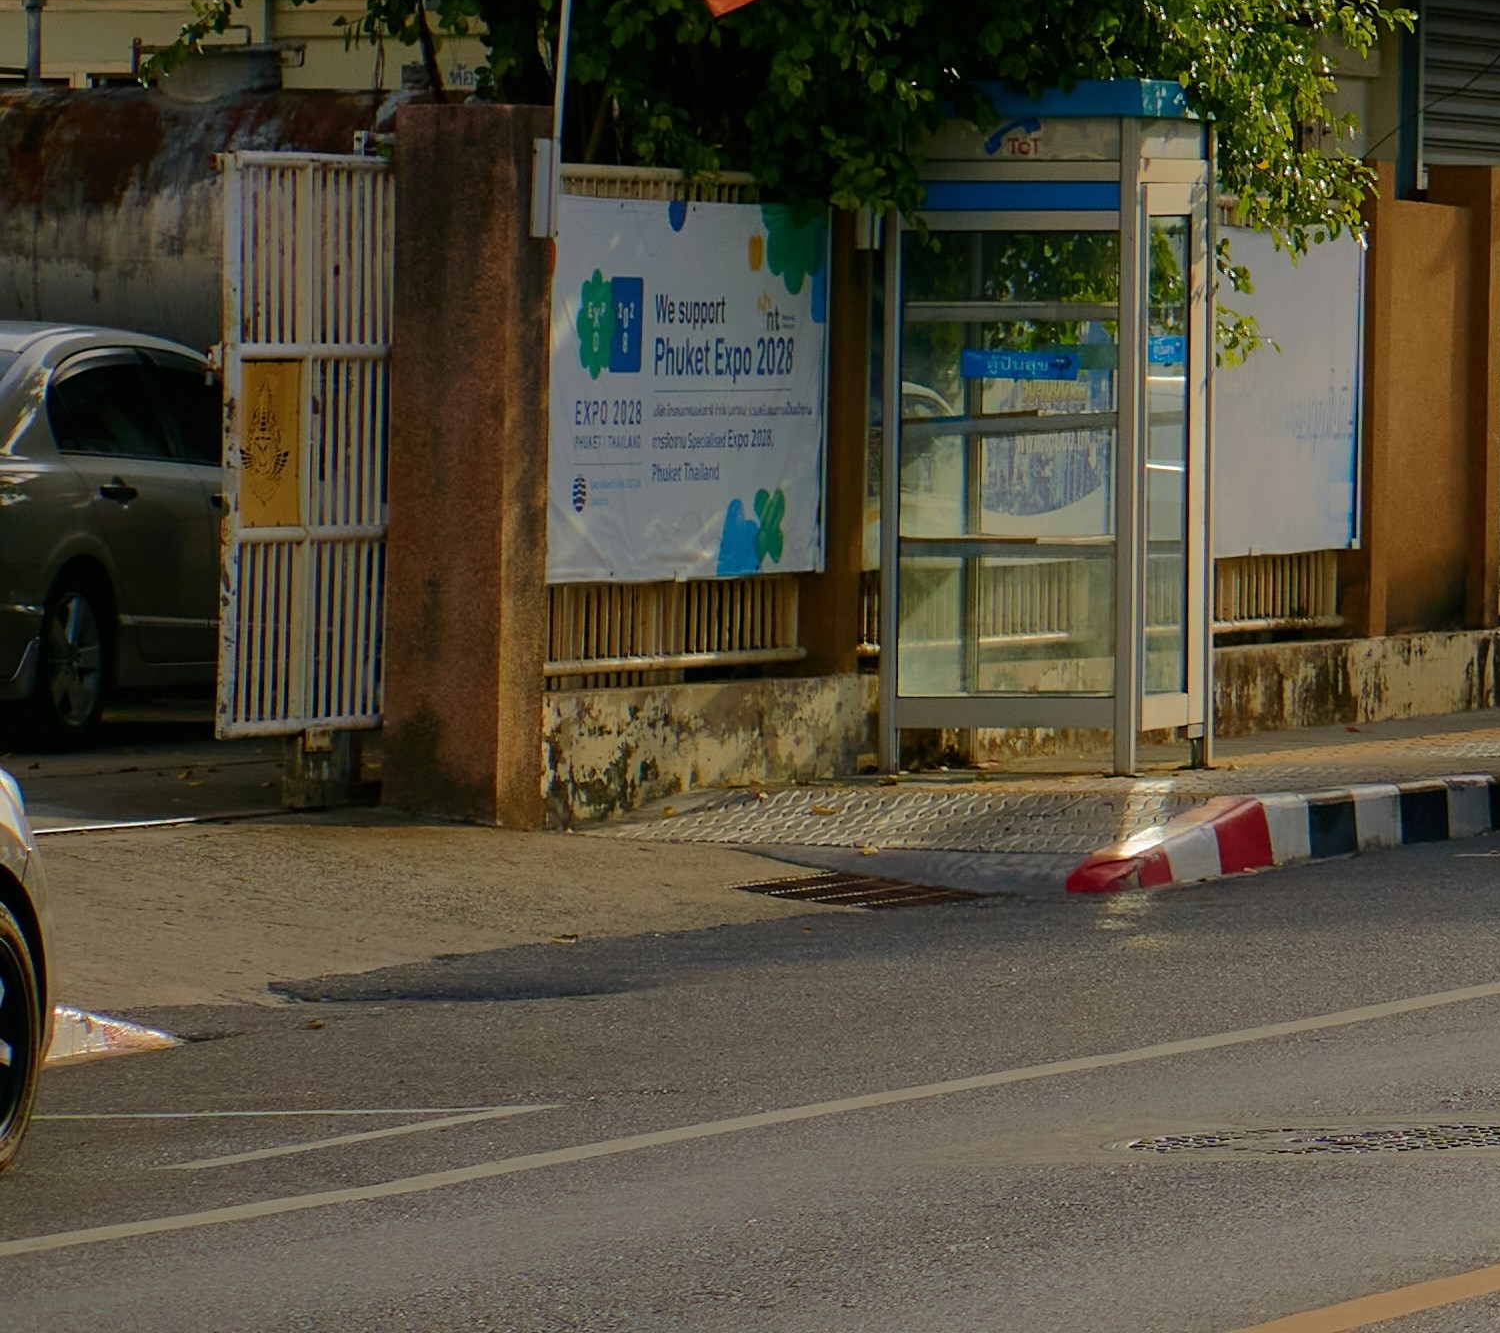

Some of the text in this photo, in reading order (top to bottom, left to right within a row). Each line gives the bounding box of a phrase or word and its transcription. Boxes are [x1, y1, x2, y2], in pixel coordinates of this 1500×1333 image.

[655, 294, 726, 330] We support
[654, 336, 795, 383] Phuket Expo 2028
[575, 399, 608, 426] EXPO
[613, 399, 642, 426] 2028
[574, 435, 642, 450] PHUKET THAILAND
[727, 429, 749, 451] Expo
[652, 462, 720, 482] Phuket Thailand
